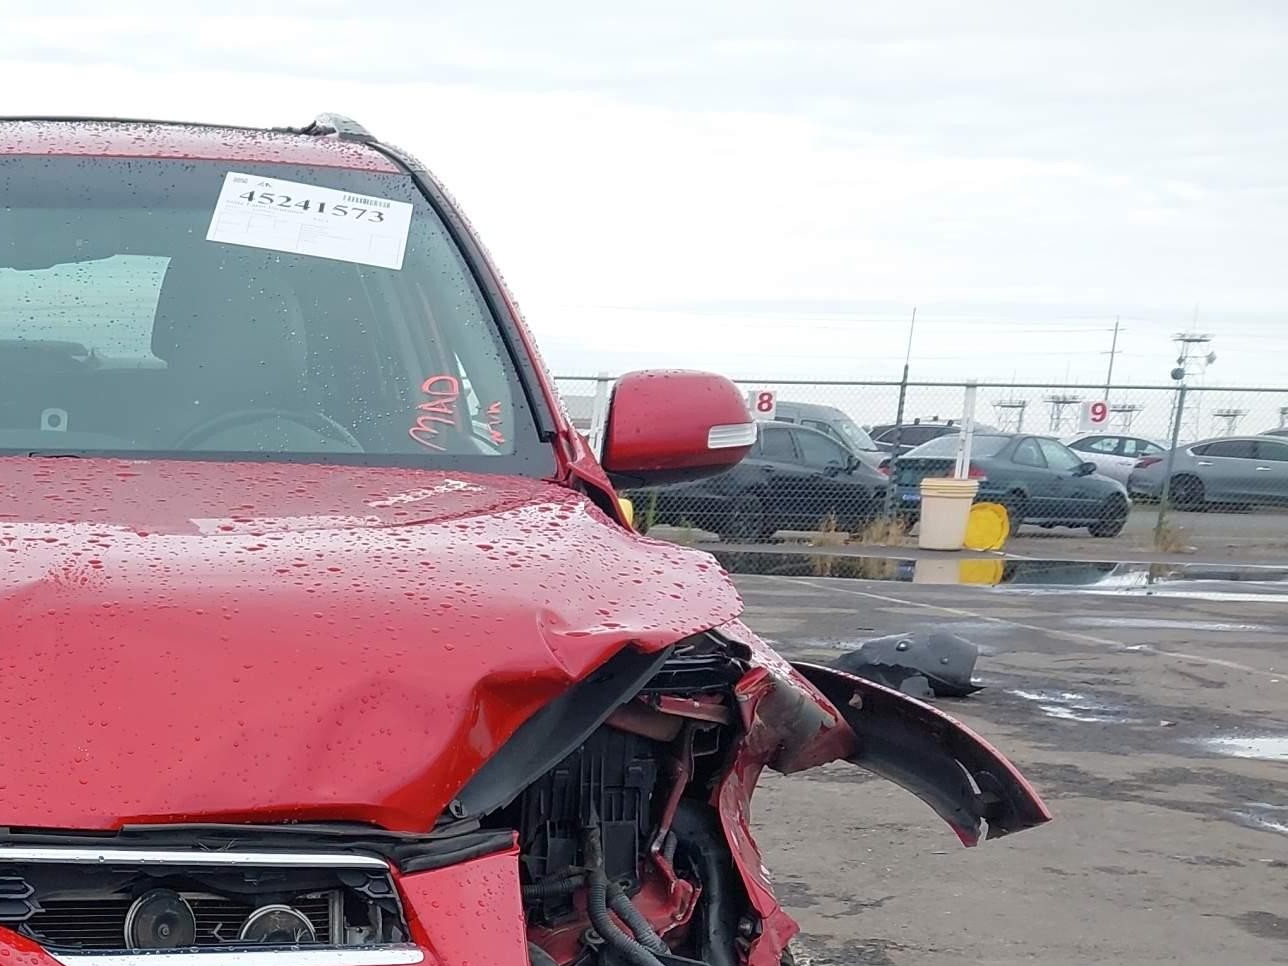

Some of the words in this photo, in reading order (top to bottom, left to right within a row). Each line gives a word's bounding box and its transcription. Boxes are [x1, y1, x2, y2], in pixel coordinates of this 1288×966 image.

[239, 190, 385, 223] 45241573
[408, 375, 460, 451] MAD
[757, 392, 773, 412] 8
[1091, 403, 1107, 422] 9
